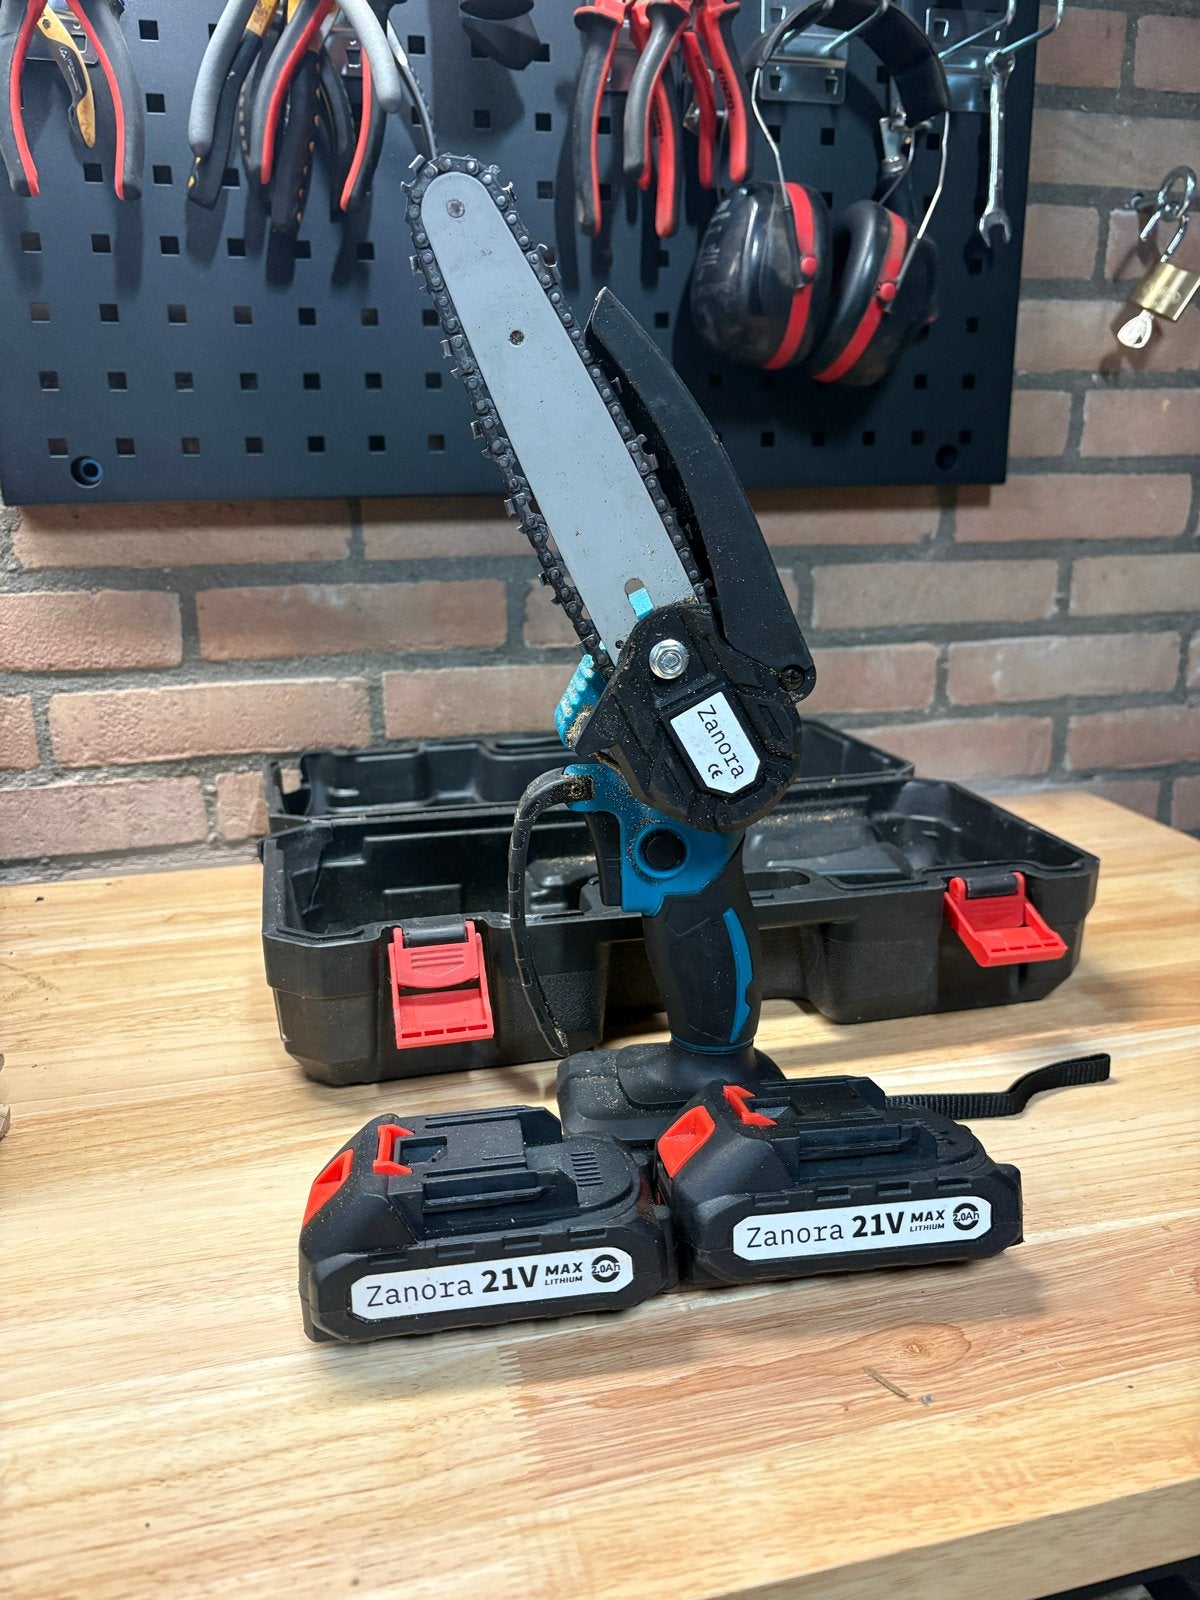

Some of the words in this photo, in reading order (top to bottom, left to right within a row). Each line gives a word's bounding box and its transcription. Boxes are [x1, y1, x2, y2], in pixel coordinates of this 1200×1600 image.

[717, 67, 735, 111] KINZO
[697, 704, 744, 780] Zanora
[746, 1222, 844, 1249] Zanora
[852, 1211, 905, 1238] 21V
[910, 1209, 946, 1223] MAX
[909, 1222, 946, 1233] LITHIUM
[952, 1210, 980, 1222] 2.0Ah
[544, 1275, 583, 1287] LITHIUM
[591, 1262, 621, 1275] 2.0Ah
[366, 1278, 473, 1308] Zanora
[481, 1264, 539, 1294] 21V
[545, 1261, 584, 1277] MAX
